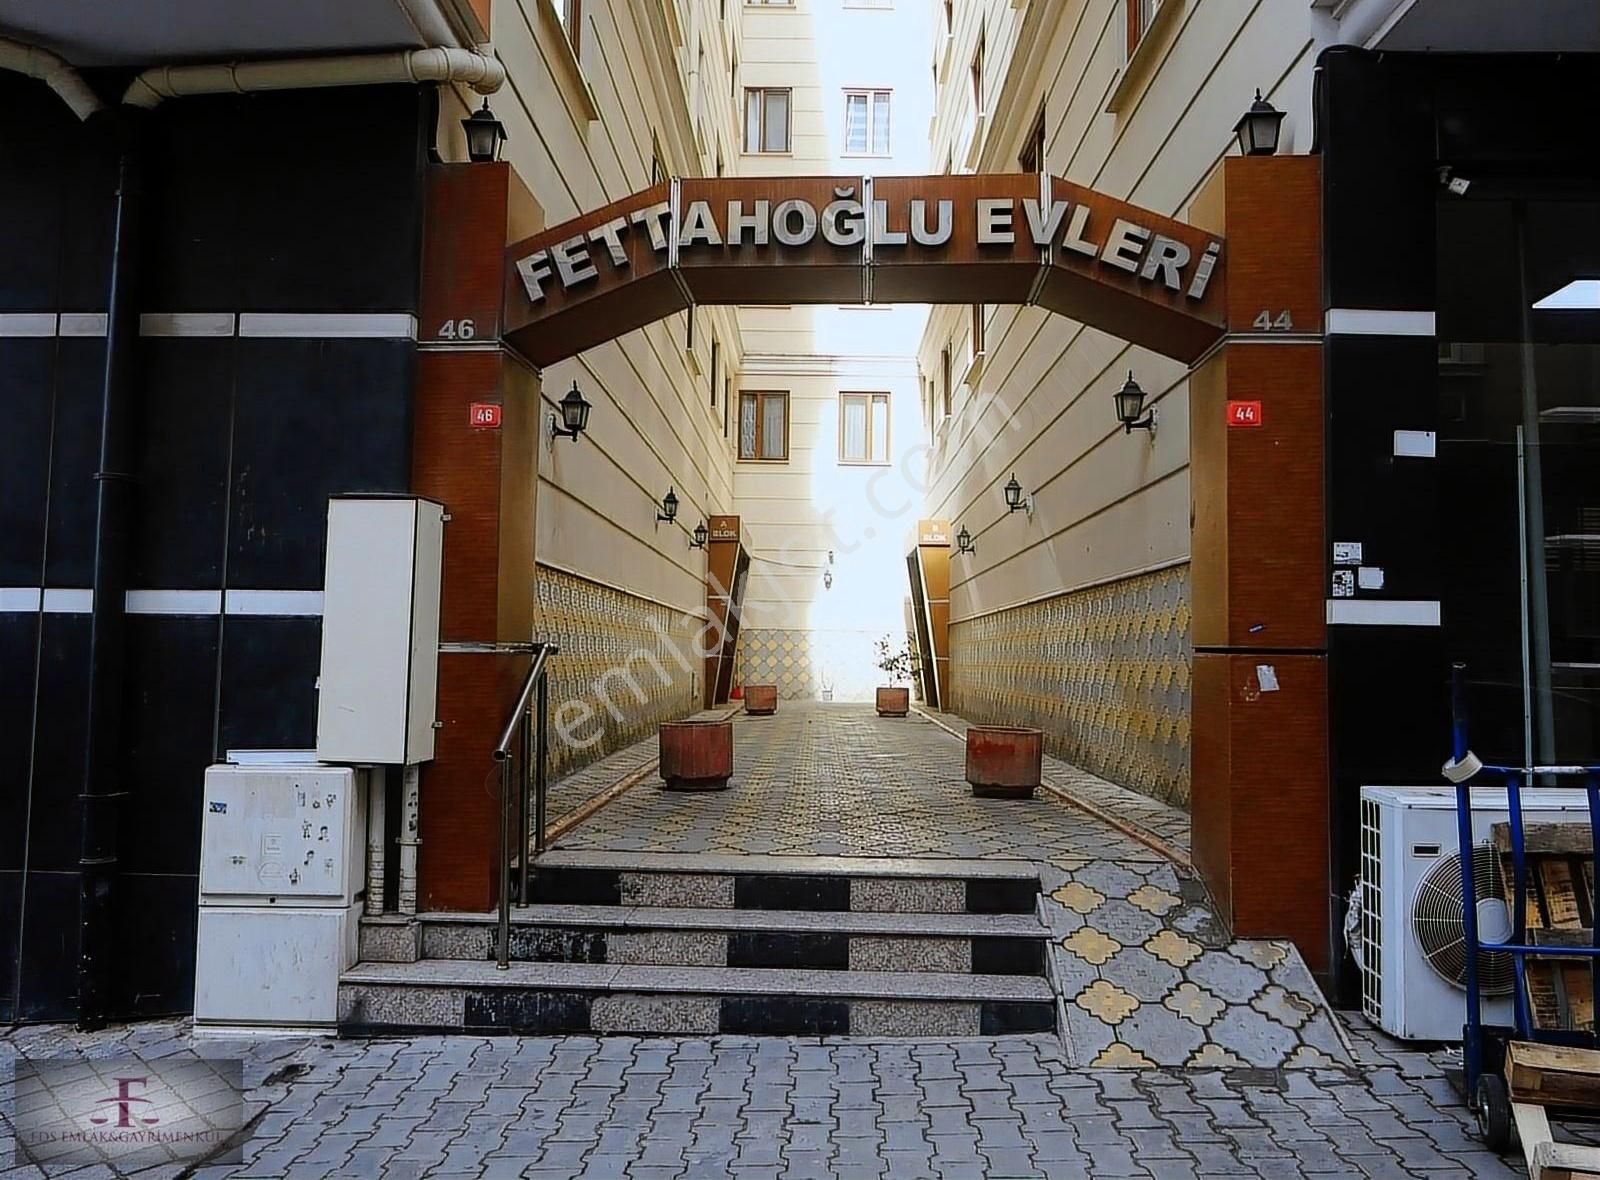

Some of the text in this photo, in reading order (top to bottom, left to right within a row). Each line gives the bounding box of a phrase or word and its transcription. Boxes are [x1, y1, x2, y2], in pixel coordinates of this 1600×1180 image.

[515, 186, 953, 302] FETTAHOĞLU
[438, 319, 474, 339] 46
[1252, 309, 1293, 330] 44
[477, 408, 493, 422] 46
[1235, 406, 1254, 420] 44
